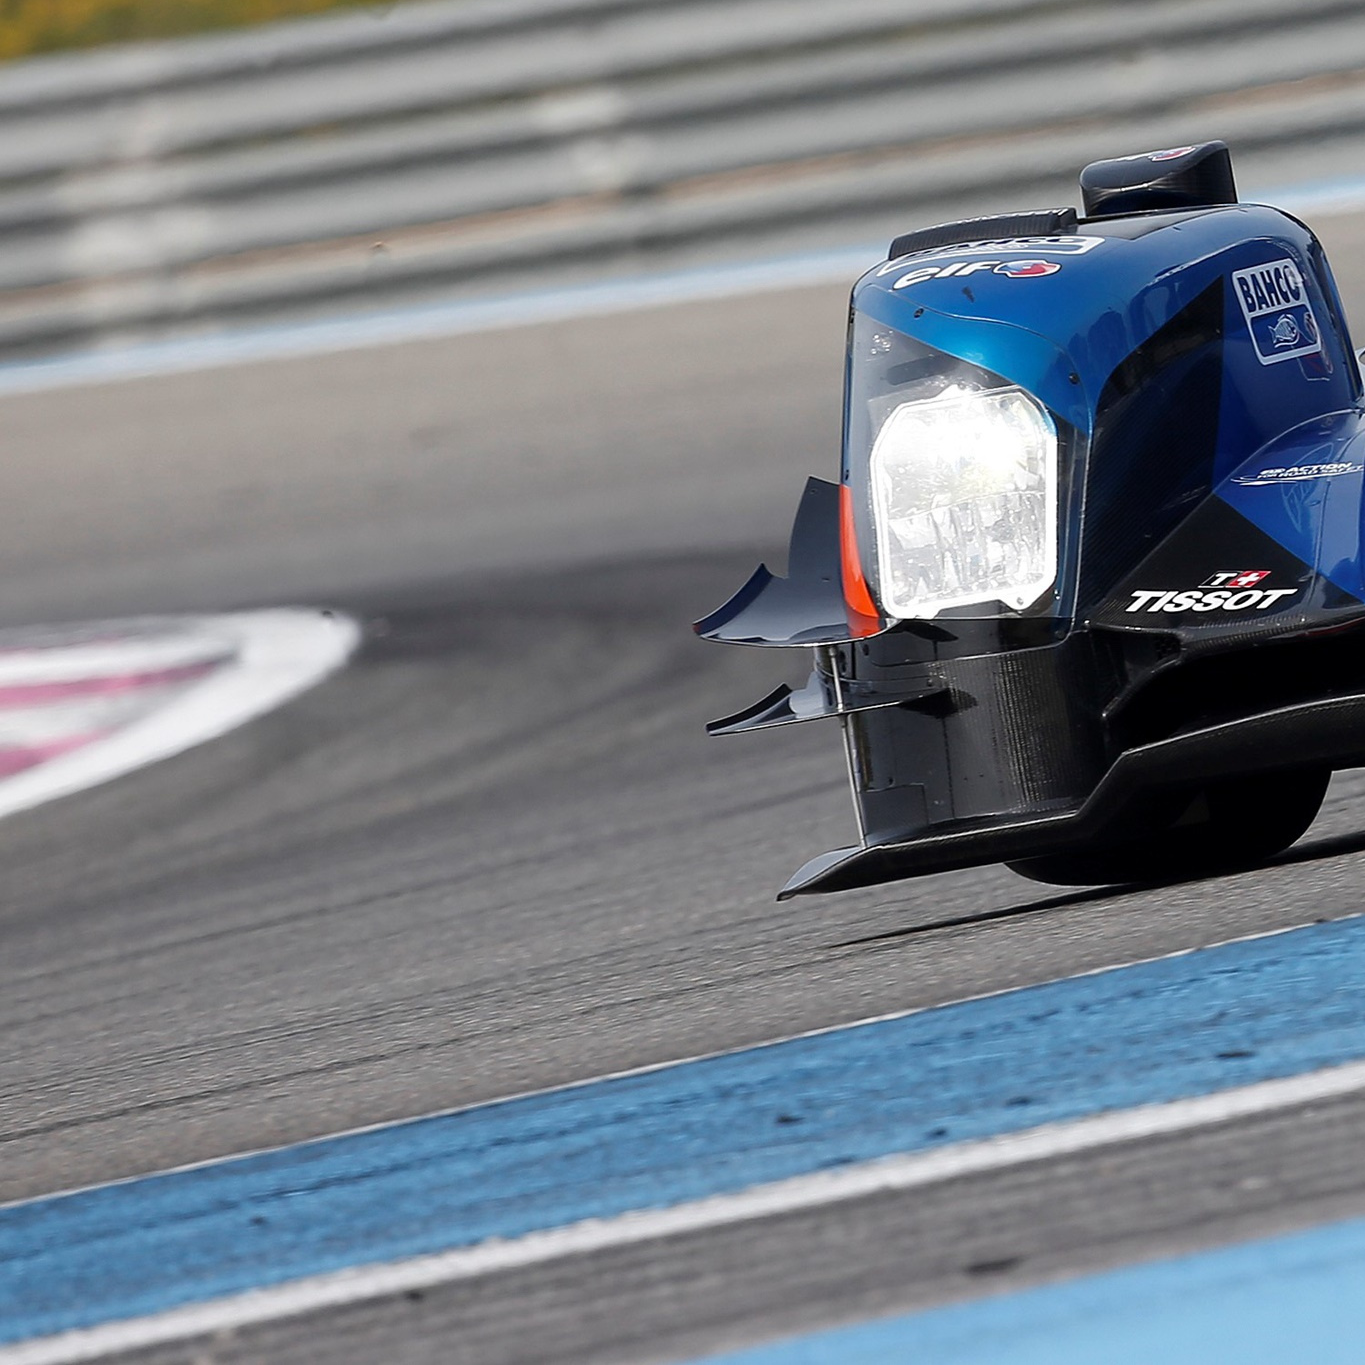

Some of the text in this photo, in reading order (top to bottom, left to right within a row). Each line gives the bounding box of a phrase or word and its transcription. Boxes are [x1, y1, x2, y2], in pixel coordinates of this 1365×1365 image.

[893, 260, 1001, 291] elf
[1236, 264, 1301, 314] BAHCO
[1125, 588, 1299, 613] TISSOT
